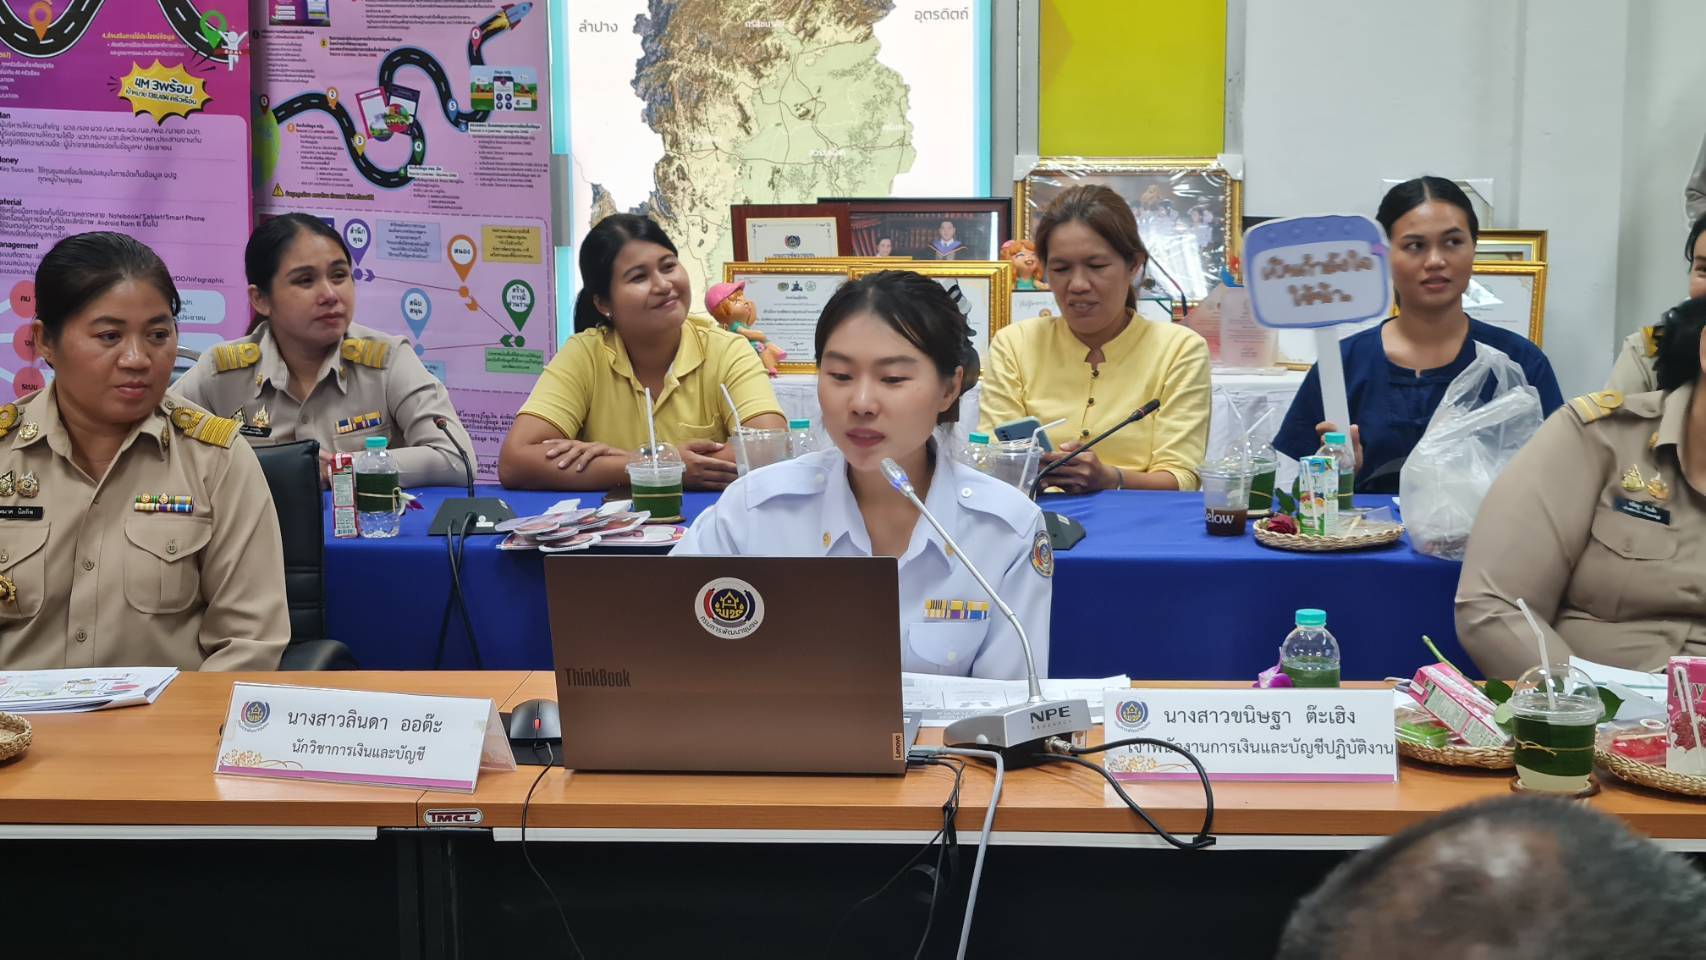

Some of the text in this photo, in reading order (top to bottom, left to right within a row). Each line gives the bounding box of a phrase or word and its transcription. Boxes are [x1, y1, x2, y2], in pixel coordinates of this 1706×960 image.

[914, 7, 969, 23] อุตรดิตถ์
[578, 20, 618, 34] ลำปาง
[134, 77, 193, 95] 4M 3พร้อม
[0, 156, 19, 165] oney
[0, 198, 22, 206] aterial
[0, 241, 38, 250] anagement
[565, 667, 631, 688] ThinkBook
[287, 709, 389, 731] นางสาวลินดา
[400, 713, 443, 734] ออต๊ะ
[1030, 706, 1071, 723] NPE
[1163, 704, 1356, 731] นางสาวขนิษฐา ต๊ะเฮิง
[292, 738, 426, 766] นักวิชาการเงินและบัญชี
